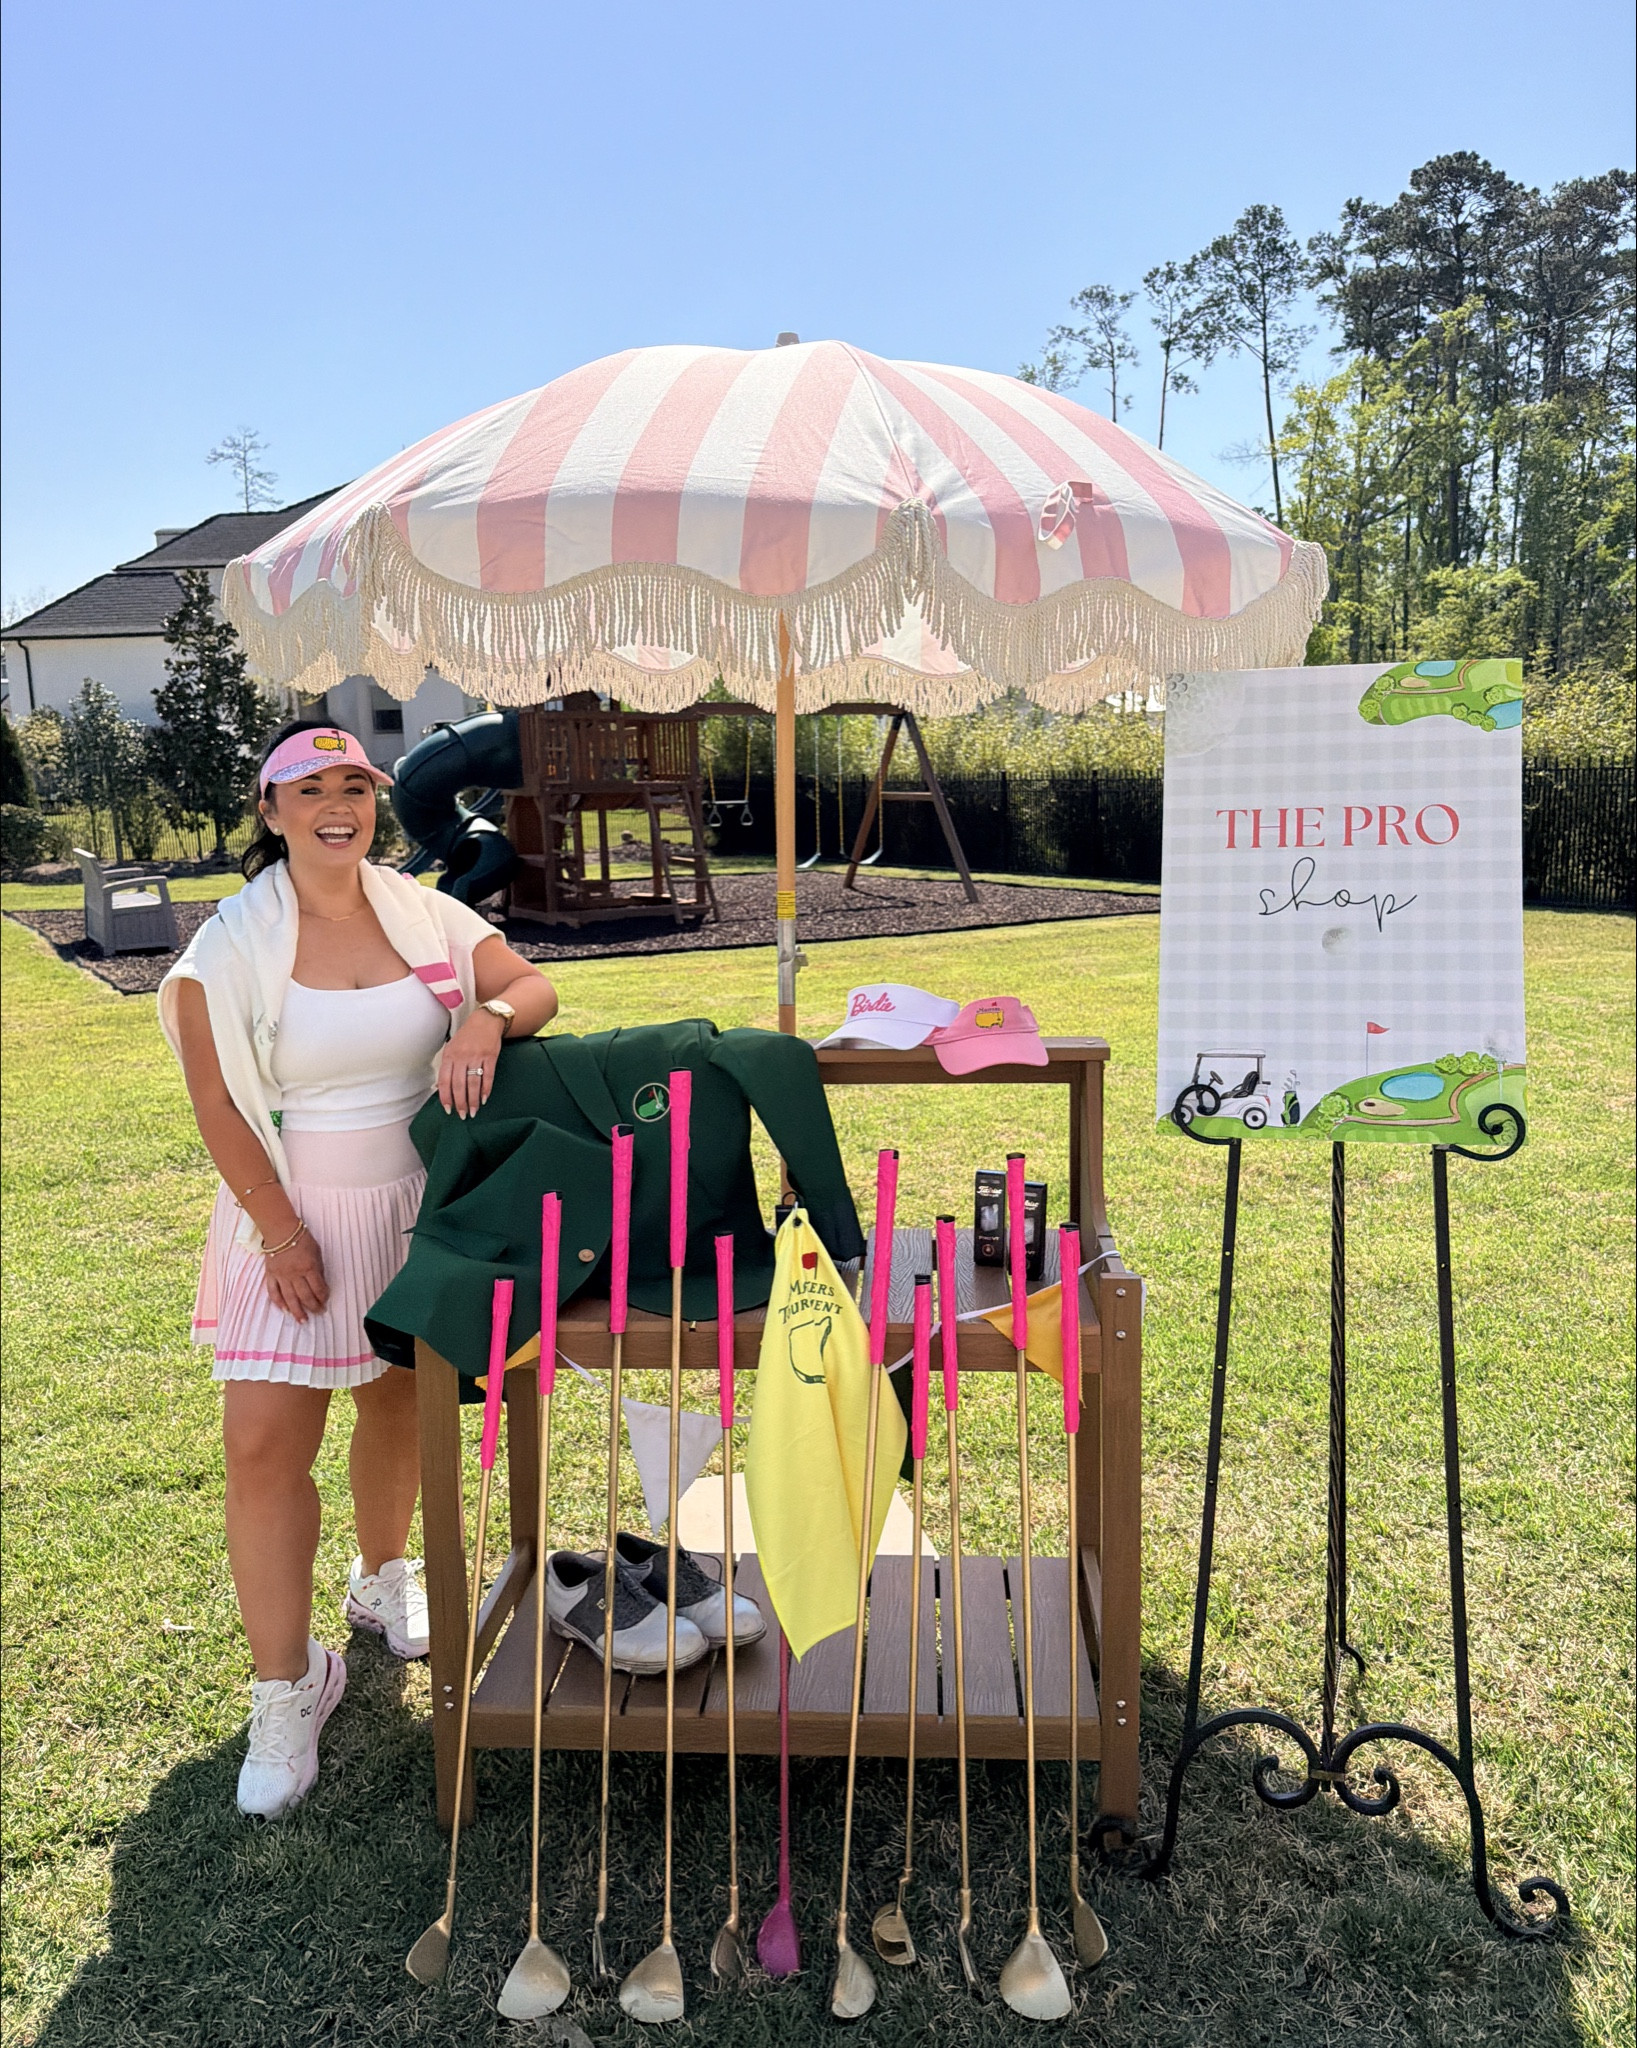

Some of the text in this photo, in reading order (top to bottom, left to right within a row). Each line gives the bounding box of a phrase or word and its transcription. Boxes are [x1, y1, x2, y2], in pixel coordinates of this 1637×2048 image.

[1216, 803, 1460, 849] THE PRO
[1258, 856, 1418, 933] shop
[850, 991, 897, 1017] Birdie
